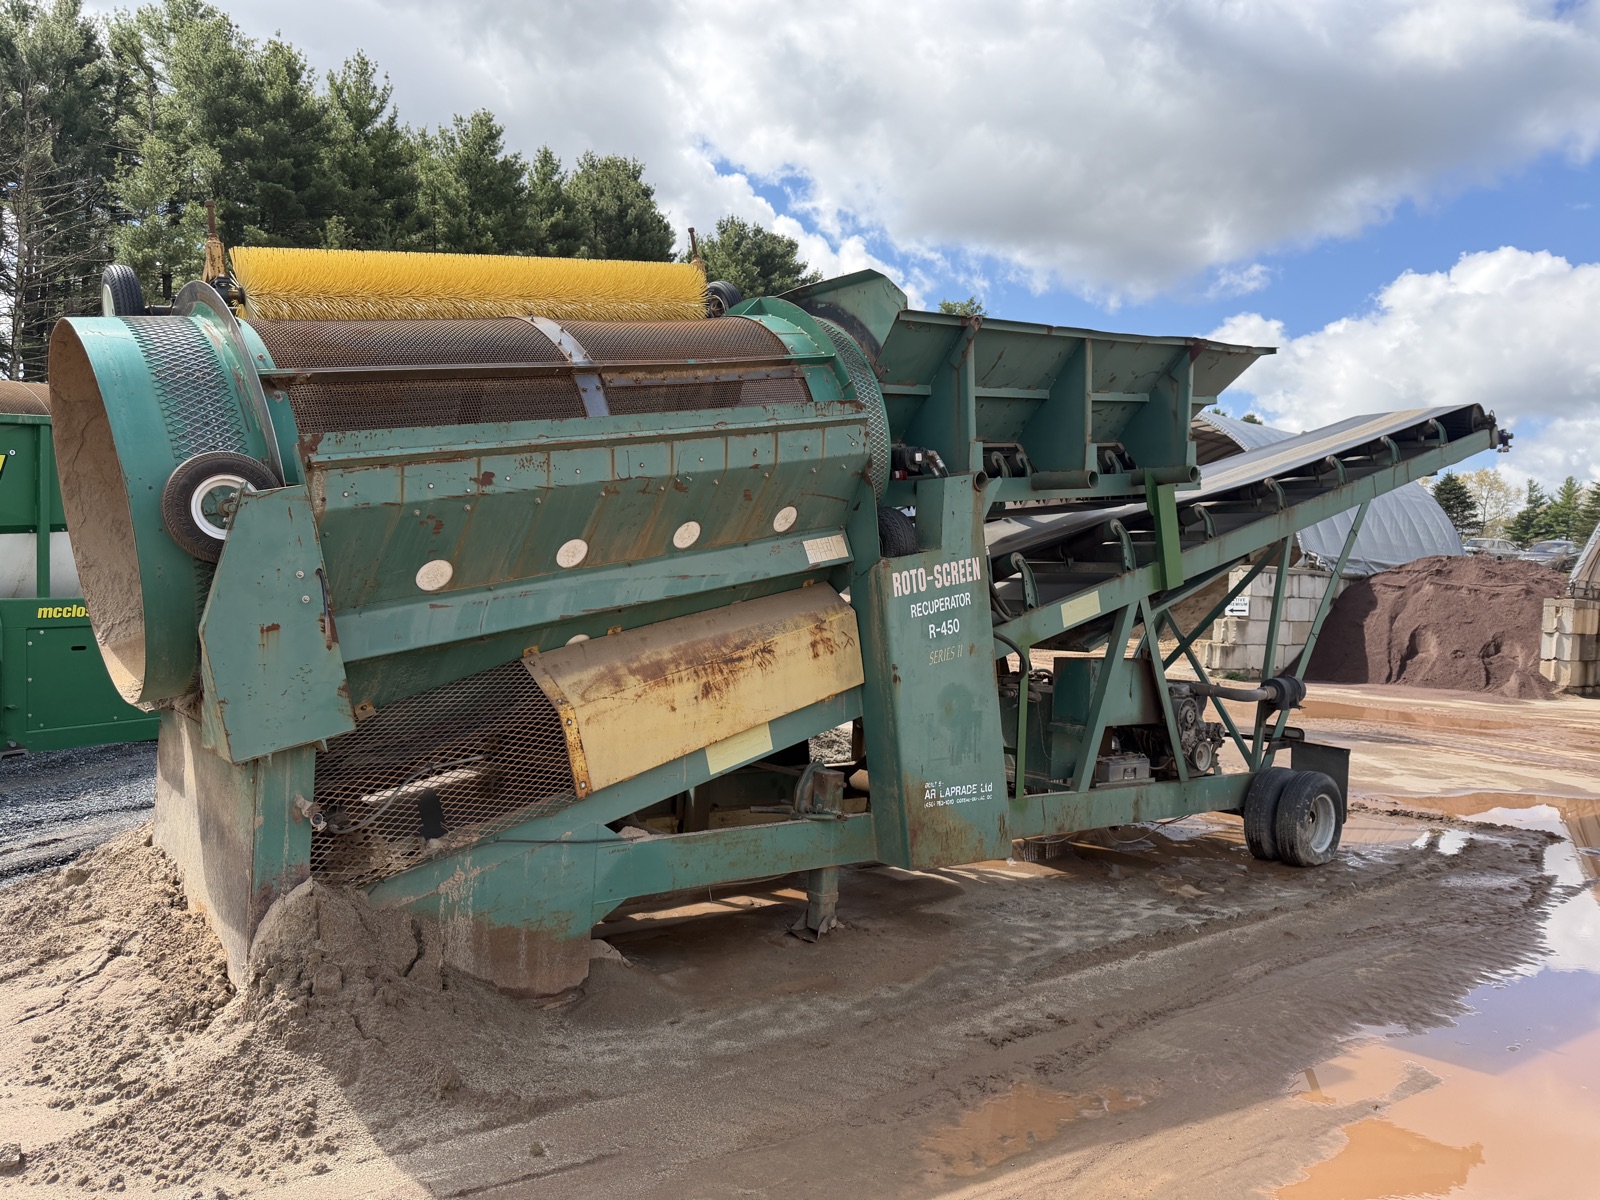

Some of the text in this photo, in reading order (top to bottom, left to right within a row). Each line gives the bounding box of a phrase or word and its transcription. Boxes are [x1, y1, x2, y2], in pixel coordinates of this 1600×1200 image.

[892, 556, 981, 598] ROTO-SCREEN
[910, 592, 972, 618] RECUPERATOR
[929, 618, 960, 639] R-450
[929, 644, 963, 666] SERIES II
[939, 784, 978, 798] LAPRADE
[980, 782, 993, 793] Ltd
